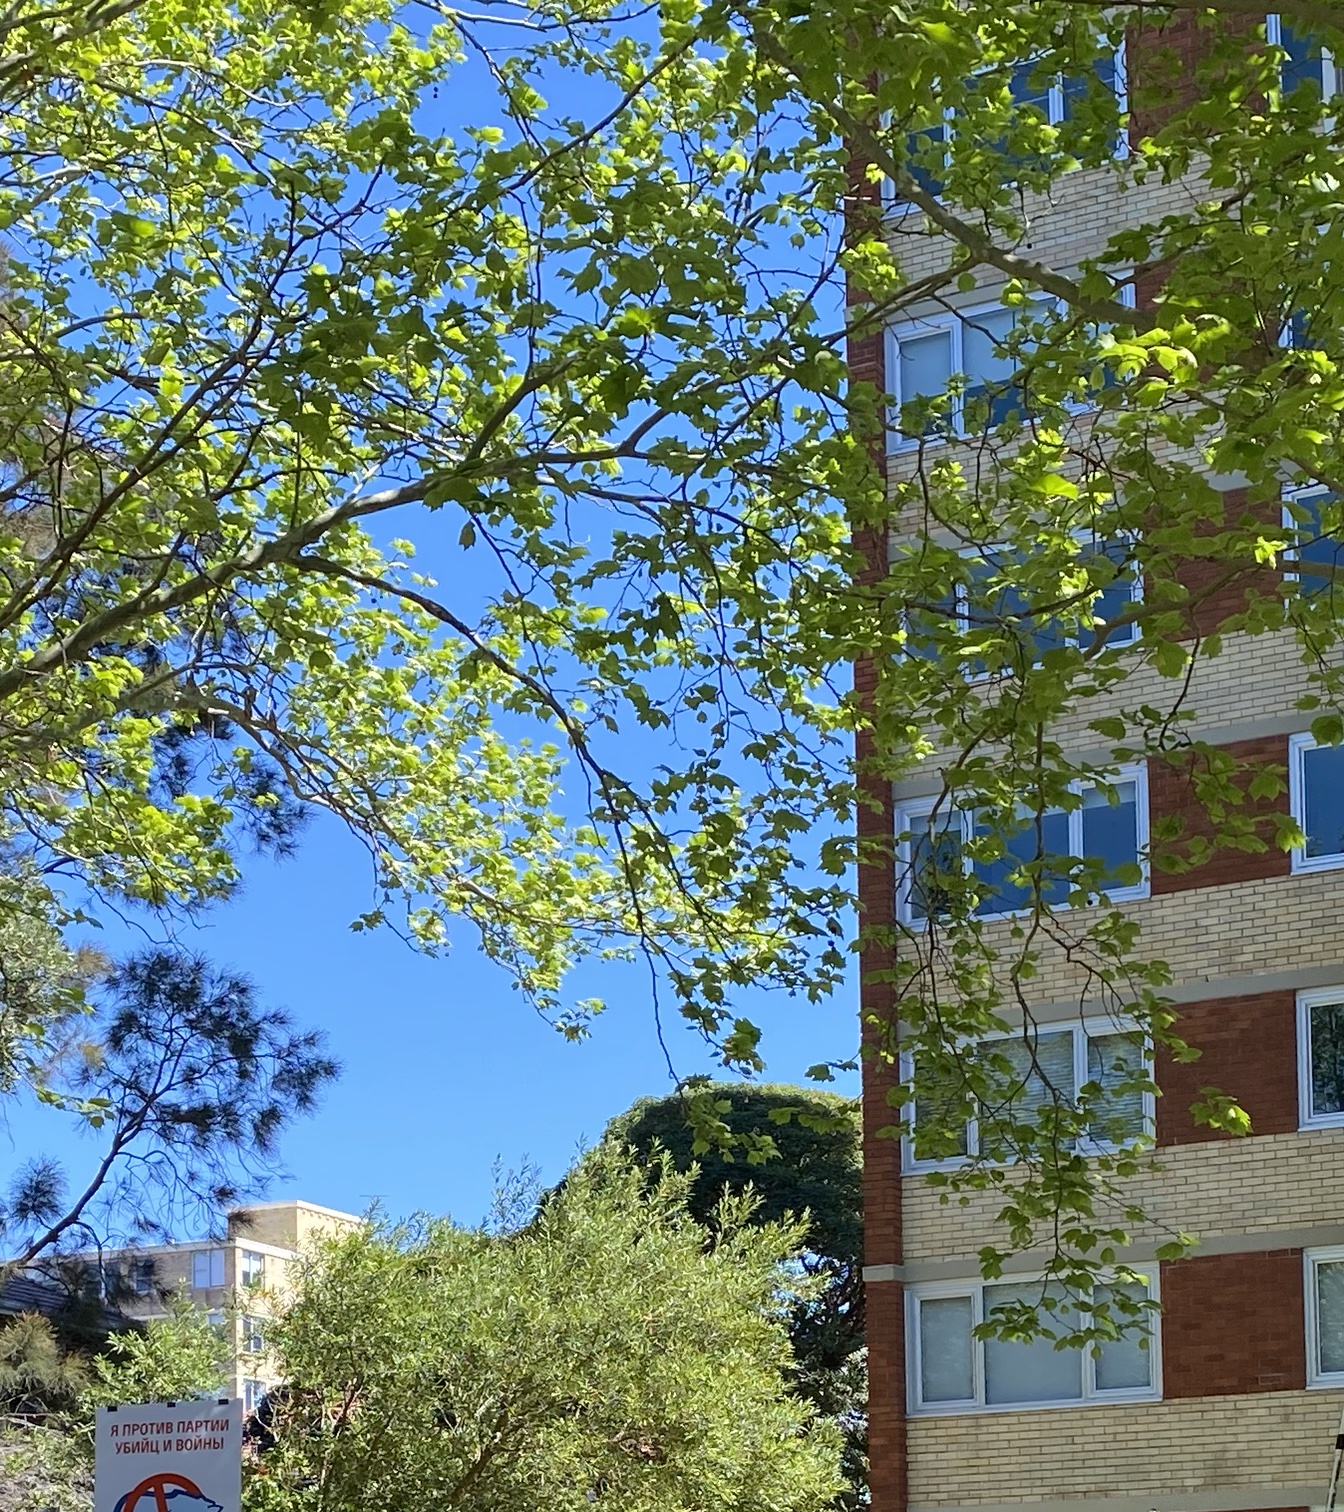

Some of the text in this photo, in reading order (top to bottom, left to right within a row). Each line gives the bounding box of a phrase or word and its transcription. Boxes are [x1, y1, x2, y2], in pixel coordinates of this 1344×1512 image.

[110, 1419, 229, 1437] Я ПРОТИВ ПАРТИИ
[115, 1435, 224, 1455] УБИЙЦ И ВОЙНЫ
